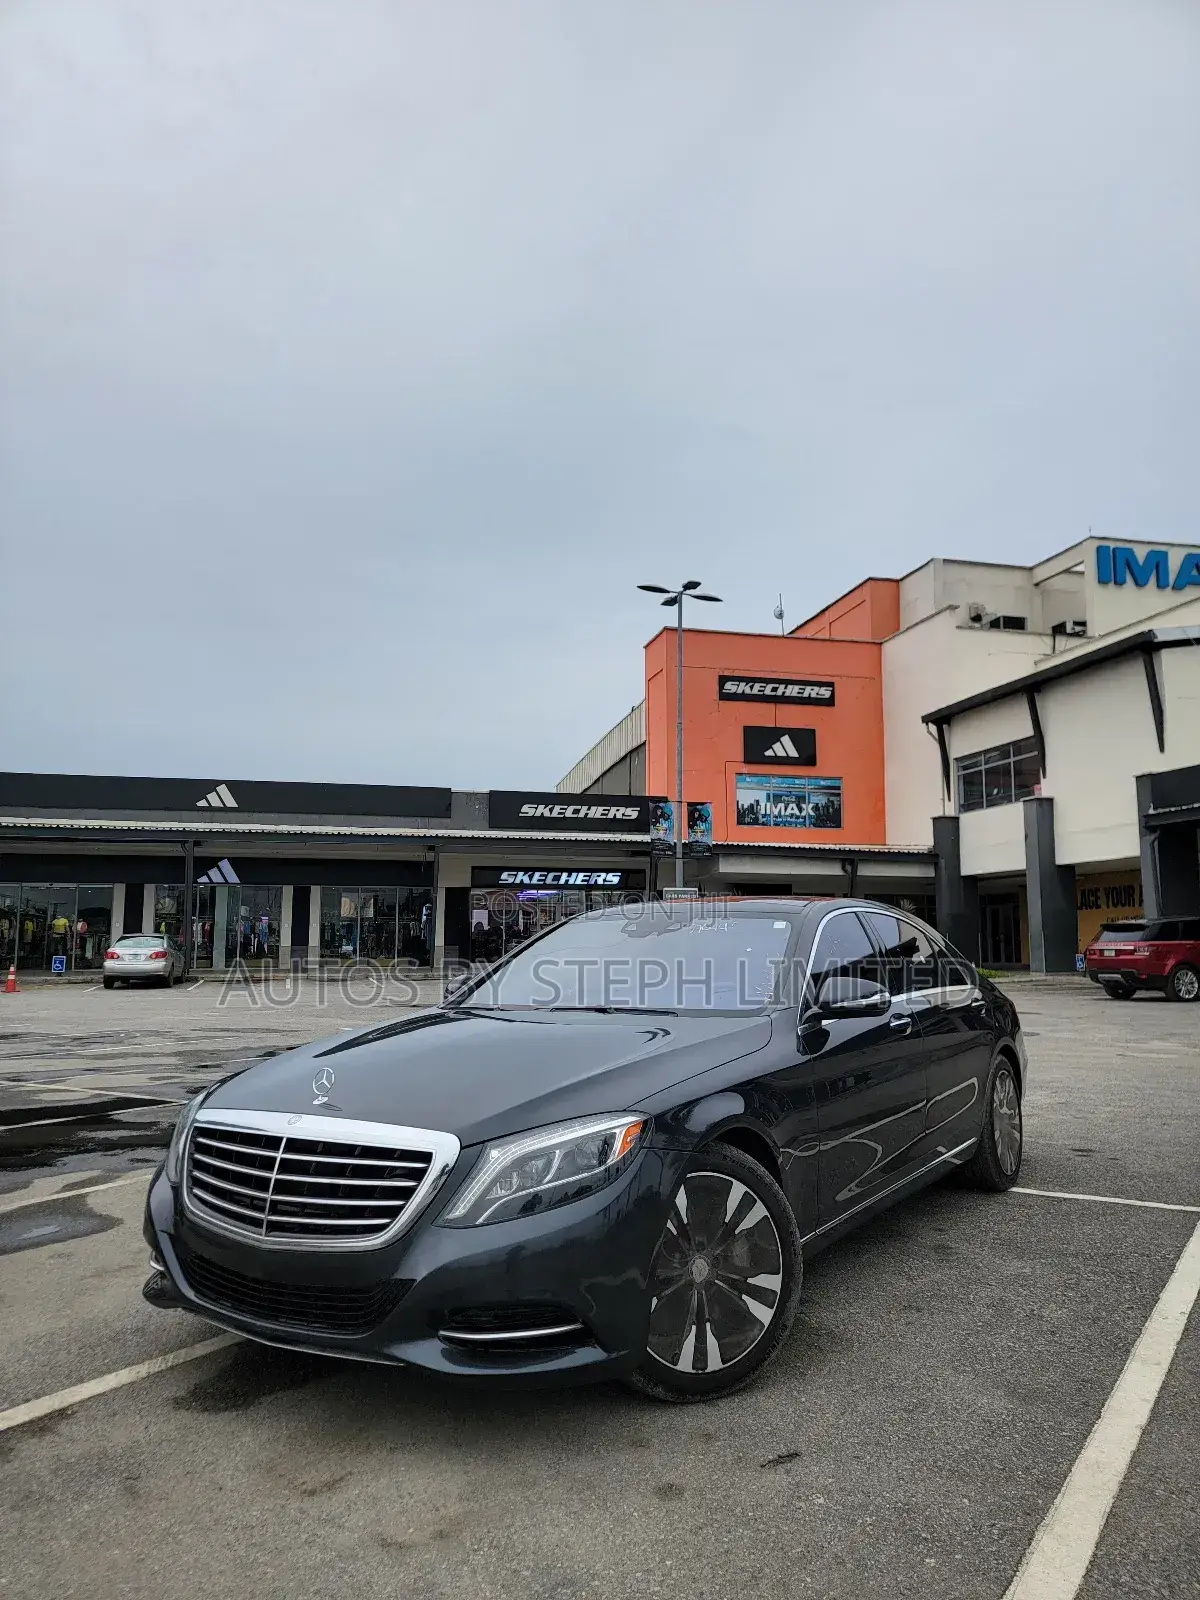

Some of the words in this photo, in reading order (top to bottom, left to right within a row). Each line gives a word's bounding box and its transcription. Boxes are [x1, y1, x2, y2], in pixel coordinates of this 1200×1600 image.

[722, 681, 833, 699] SKECHERS
[519, 804, 641, 820] SKECHERS
[761, 803, 816, 815] IMAX
[499, 871, 621, 885] SKECHERS
[1103, 884, 1136, 909] YOUR
